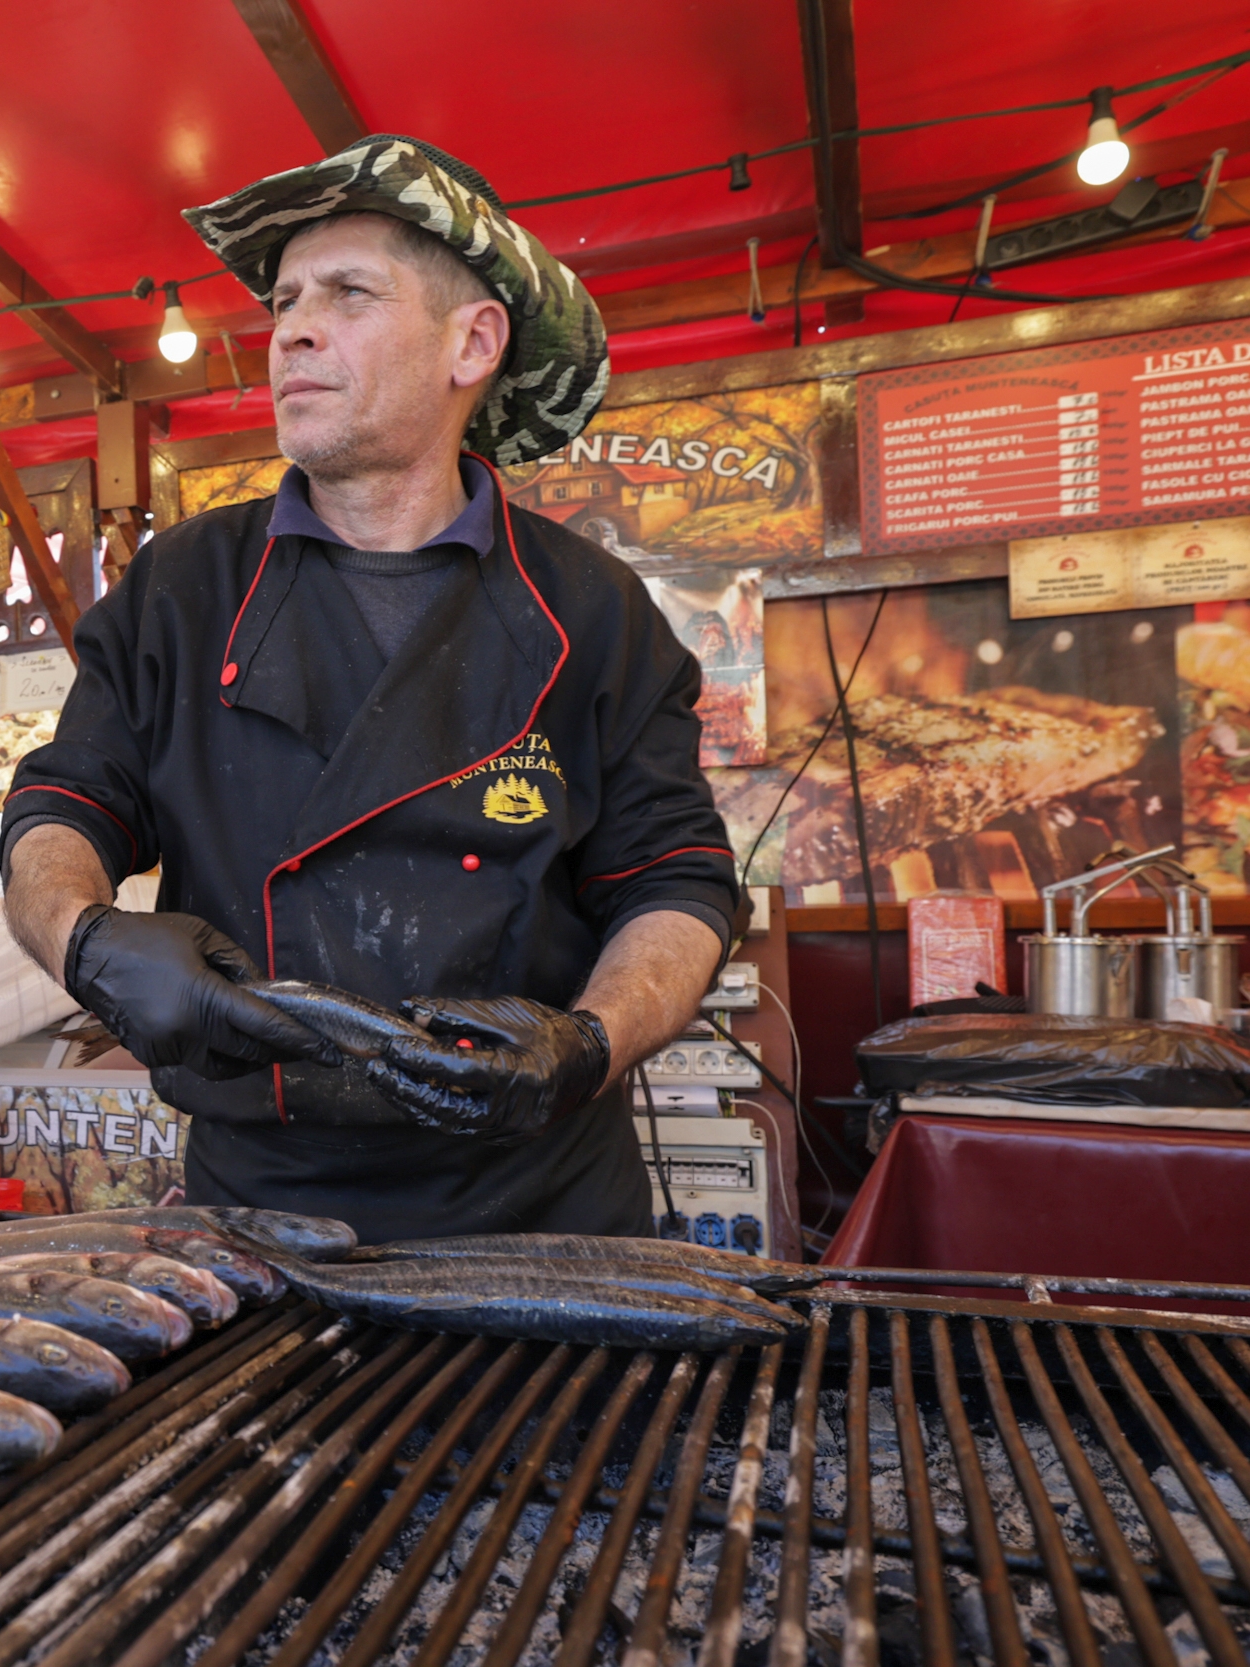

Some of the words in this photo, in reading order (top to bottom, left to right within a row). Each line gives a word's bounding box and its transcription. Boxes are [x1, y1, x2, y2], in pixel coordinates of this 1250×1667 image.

[1144, 347, 1226, 375] LISTA
[1140, 379, 1204, 397] JAMBON
[1140, 392, 1222, 412] PASTRAMA
[1225, 388, 1250, 402] OA
[883, 414, 942, 432] CARTOFI
[944, 404, 1022, 423] TARANESTI
[1140, 408, 1223, 428] PASTRAMA
[1225, 404, 1250, 418] OA
[929, 426, 971, 441] CASEI
[1141, 429, 1184, 444] PIEPT
[1187, 425, 1209, 439] DE
[1212, 421, 1240, 436] PUI
[884, 444, 943, 461] CARNATI
[946, 433, 1023, 453] TARANESTI
[1141, 441, 1213, 459] CIUPERCI
[1215, 438, 1237, 451] LA
[515, 434, 785, 490] ENEASCĂ
[885, 460, 944, 476] CARNATI
[946, 453, 985, 468] PORC
[987, 449, 1026, 464] CASA
[1141, 456, 1213, 475] SARMALE
[885, 474, 945, 490] CARNATI
[946, 469, 980, 484] OAIE
[1142, 474, 1199, 491] FASOLE
[1201, 471, 1225, 485] CU
[885, 491, 929, 505] CEAFA
[932, 486, 969, 500] PORC
[1142, 487, 1227, 507] SARAMURA
[886, 504, 944, 521] SCARITA
[946, 499, 985, 514] PORC
[886, 518, 950, 535] FRIGARUI
